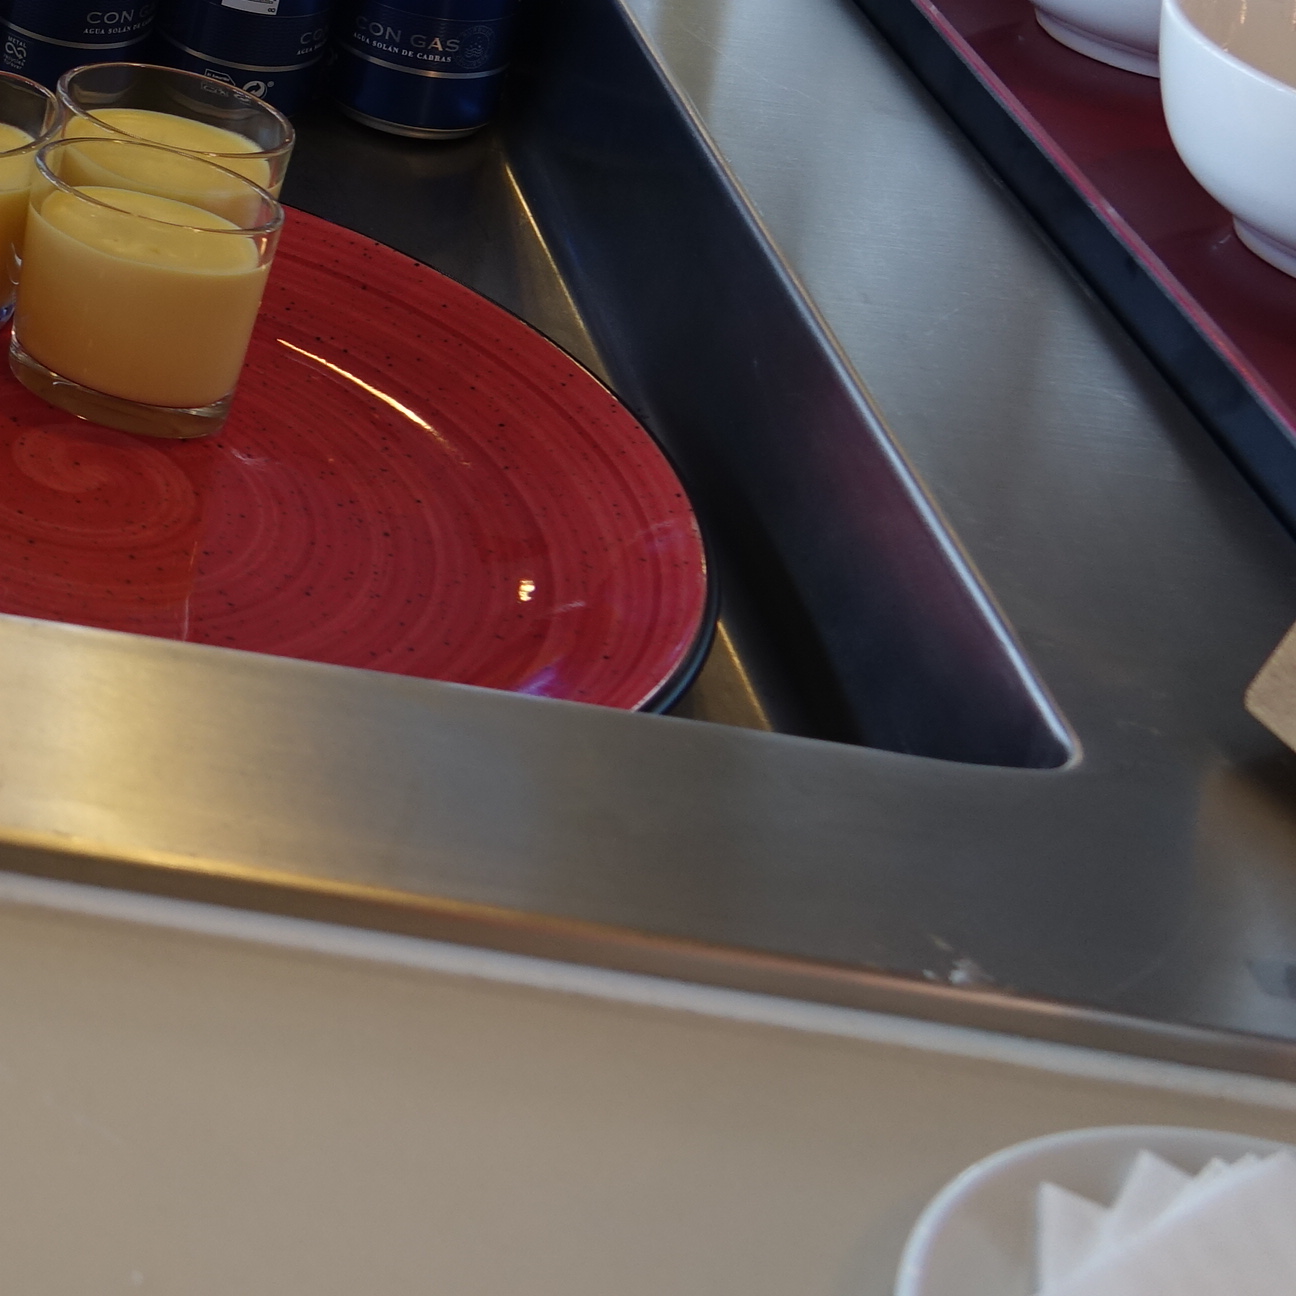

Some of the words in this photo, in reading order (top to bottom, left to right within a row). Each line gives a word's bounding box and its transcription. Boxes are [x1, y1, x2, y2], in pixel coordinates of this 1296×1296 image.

[86, 9, 135, 24] CON
[353, 31, 370, 45] AGUA
[402, 47, 414, 58] DE
[416, 52, 452, 63] CABRAS
[355, 15, 402, 43] CON
[410, 34, 461, 52] GAS
